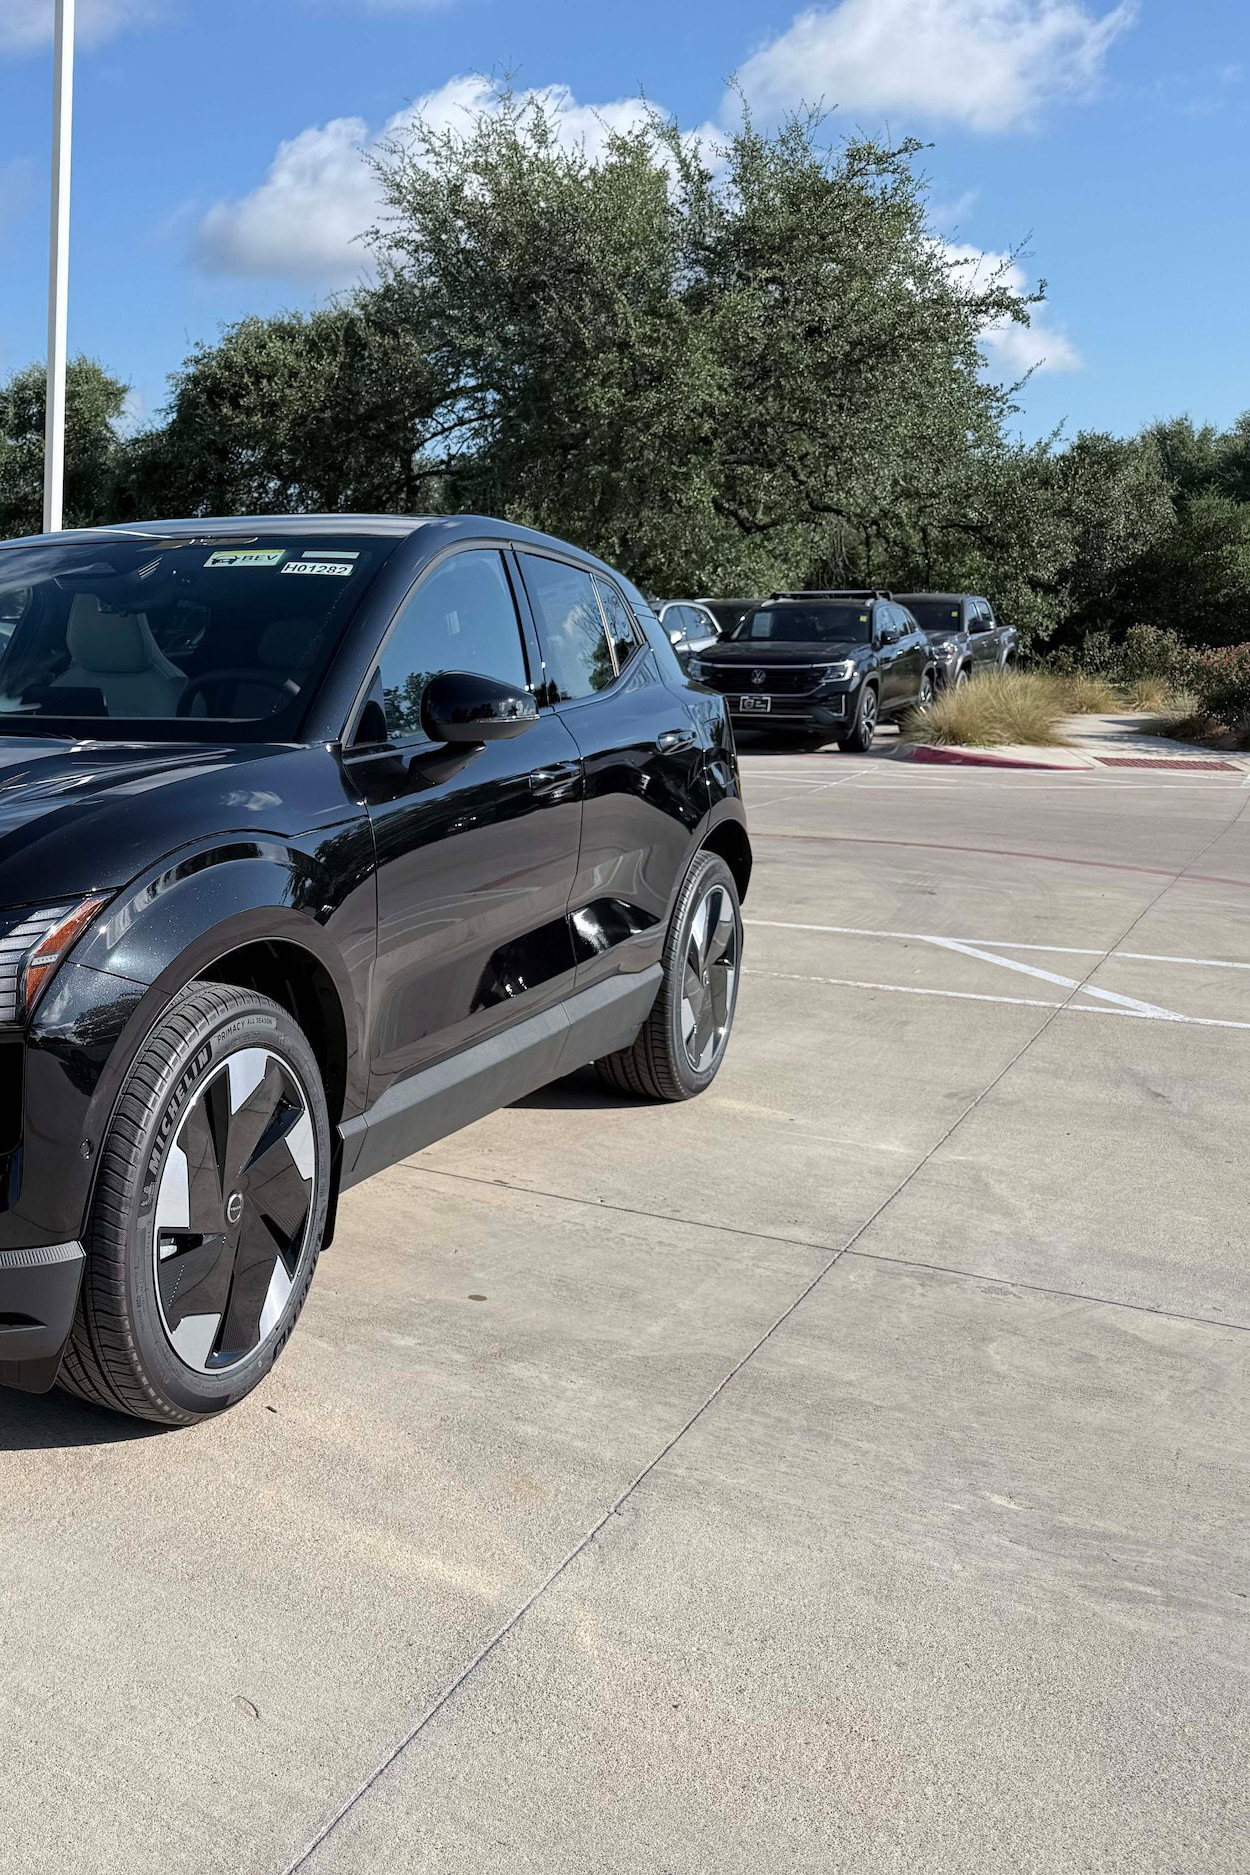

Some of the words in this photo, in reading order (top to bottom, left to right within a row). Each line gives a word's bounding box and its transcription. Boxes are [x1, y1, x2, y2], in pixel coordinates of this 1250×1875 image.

[284, 564, 348, 574] H01282
[217, 1021, 245, 1042] PRIMACY
[256, 1017, 272, 1025] SEASON
[149, 1048, 209, 1175] MICHELIN
